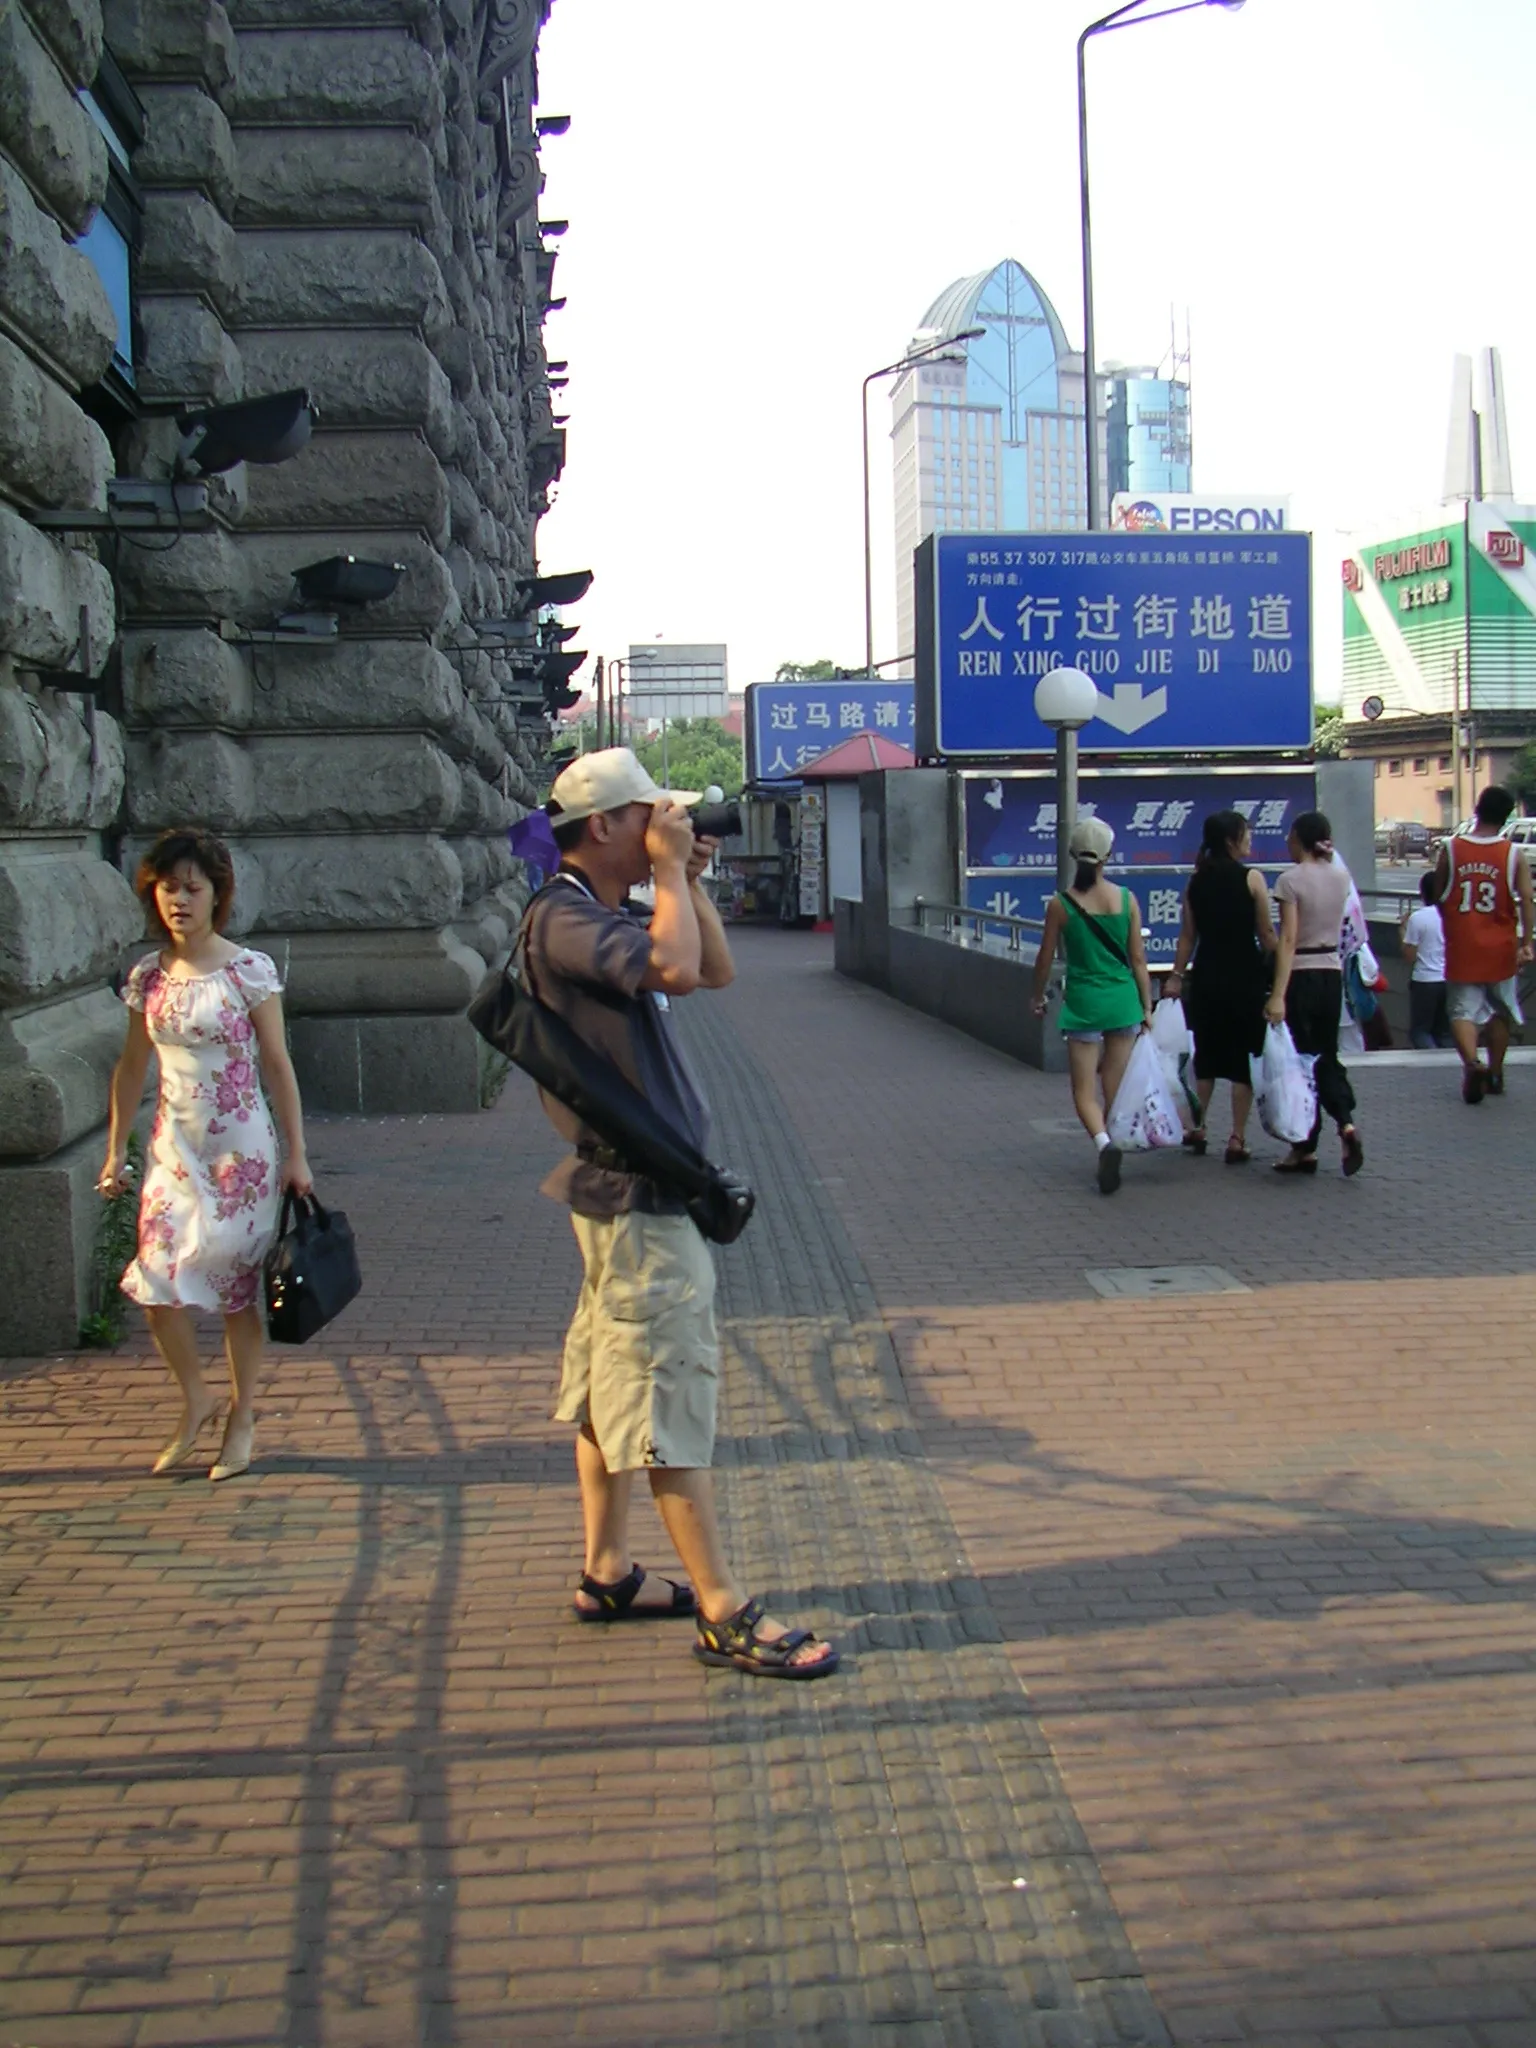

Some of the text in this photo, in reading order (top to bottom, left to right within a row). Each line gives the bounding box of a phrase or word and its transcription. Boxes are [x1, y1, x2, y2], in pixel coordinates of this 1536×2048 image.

[1170, 507, 1284, 531] EPSON
[1374, 538, 1450, 581] FUJIFILM
[958, 595, 1292, 641] 人行过街地道
[959, 649, 1292, 676] REN XING GUO JIE DI DAO
[1126, 800, 1194, 830] 更新
[1459, 880, 1496, 912] 13
